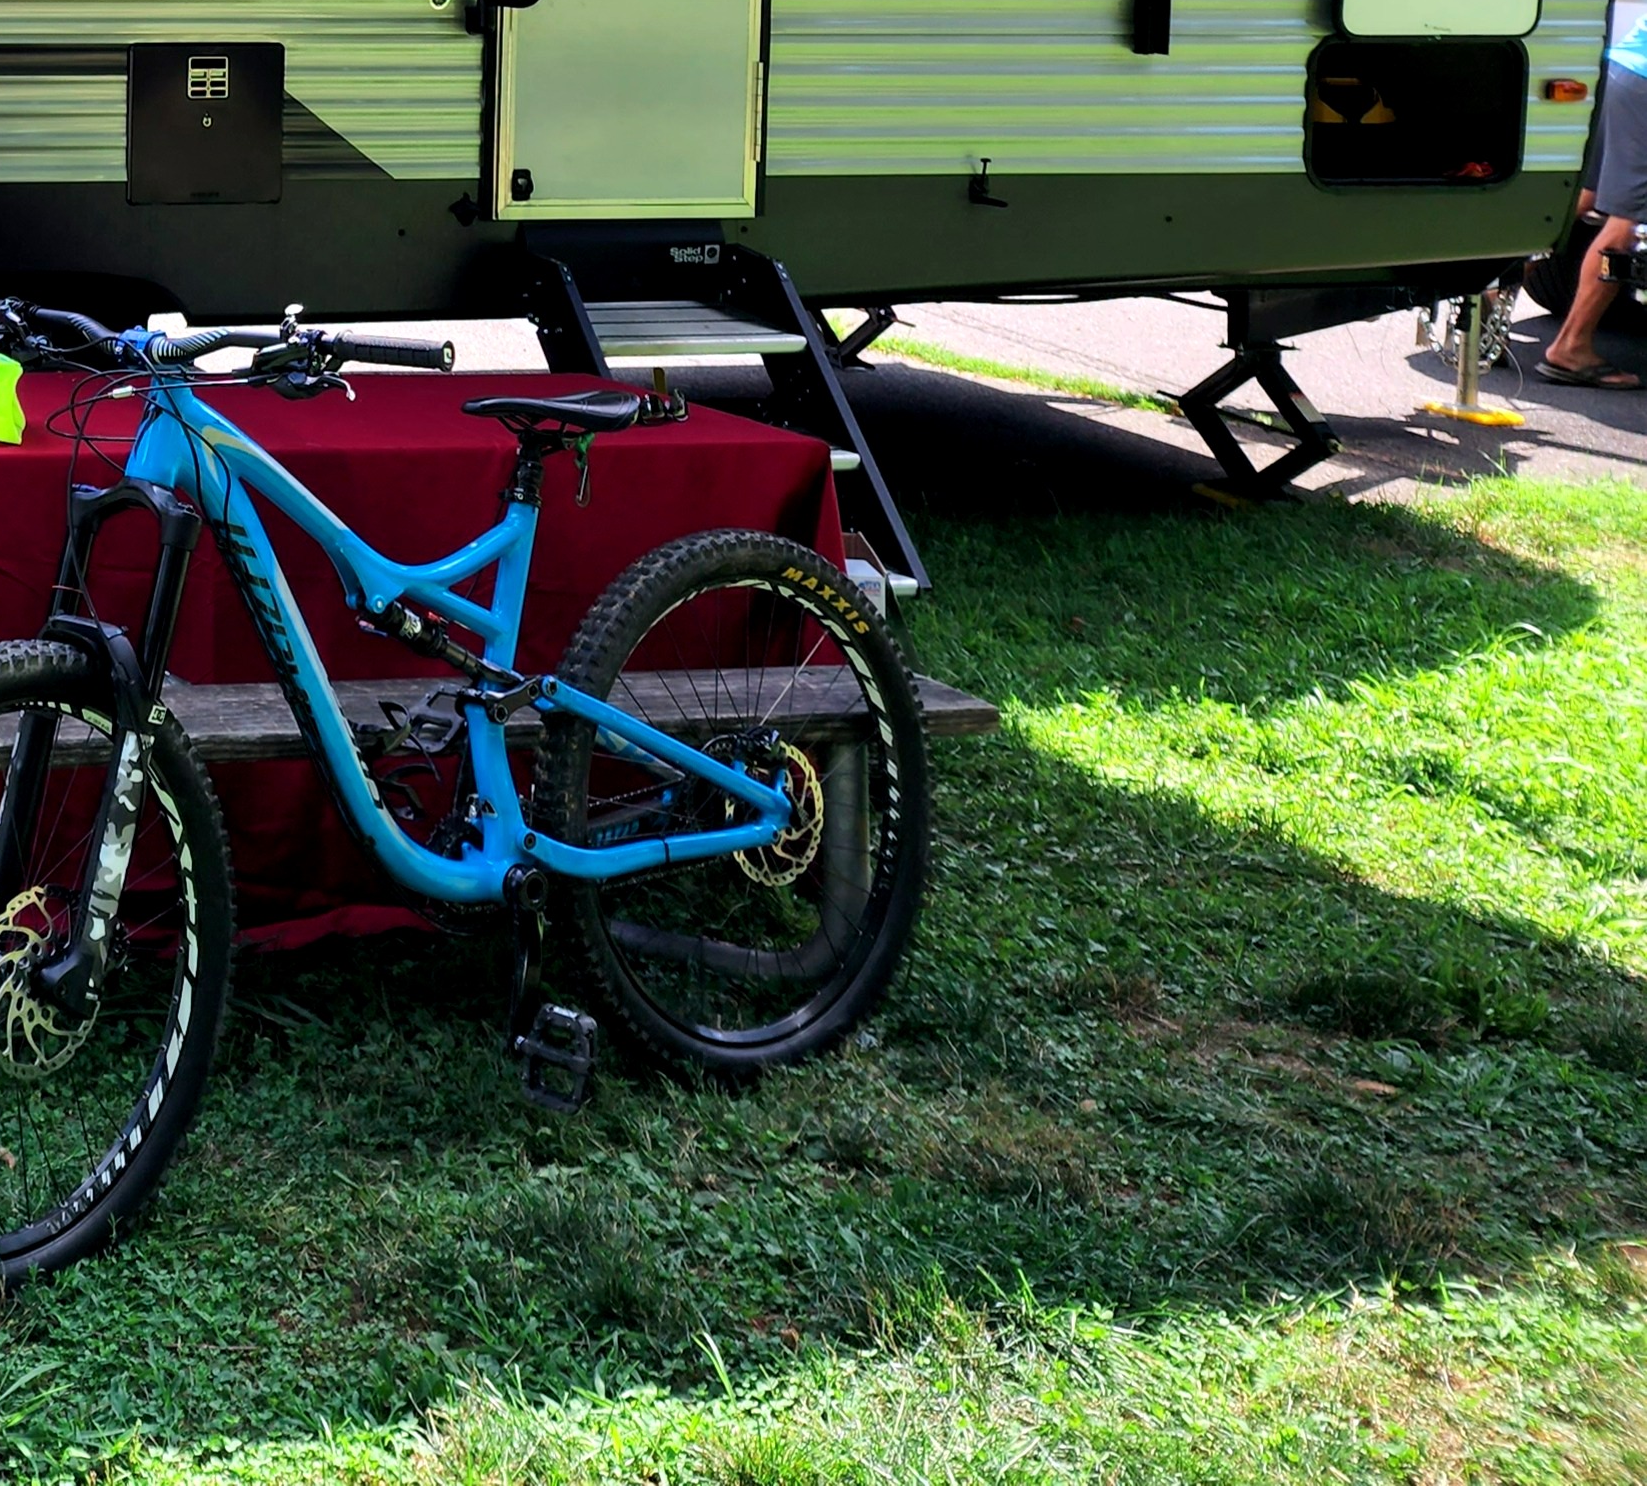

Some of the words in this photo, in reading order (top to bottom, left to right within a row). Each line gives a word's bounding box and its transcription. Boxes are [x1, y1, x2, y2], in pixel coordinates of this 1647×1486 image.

[669, 246, 702, 256] Solid
[674, 254, 704, 264] Step
[780, 566, 871, 635] MAXXIS
